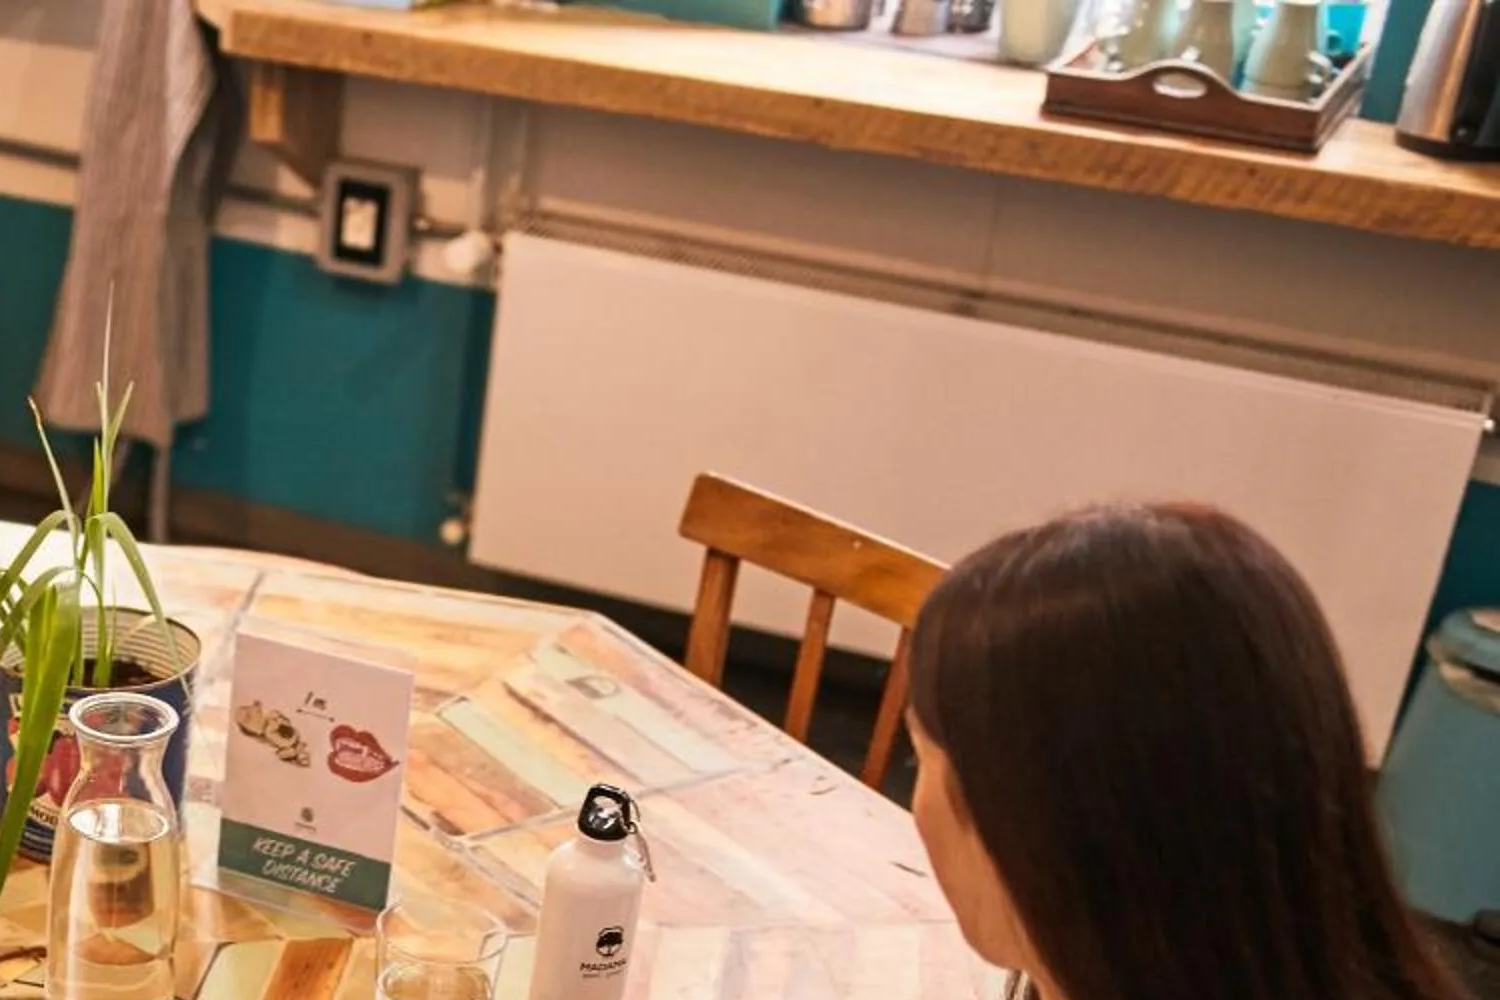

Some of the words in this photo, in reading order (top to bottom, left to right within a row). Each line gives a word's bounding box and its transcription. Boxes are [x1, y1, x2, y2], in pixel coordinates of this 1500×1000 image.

[253, 836, 296, 859] KEEP
[297, 848, 312, 865] A
[312, 852, 357, 877] SAFE
[261, 859, 343, 894] DISTANCE
